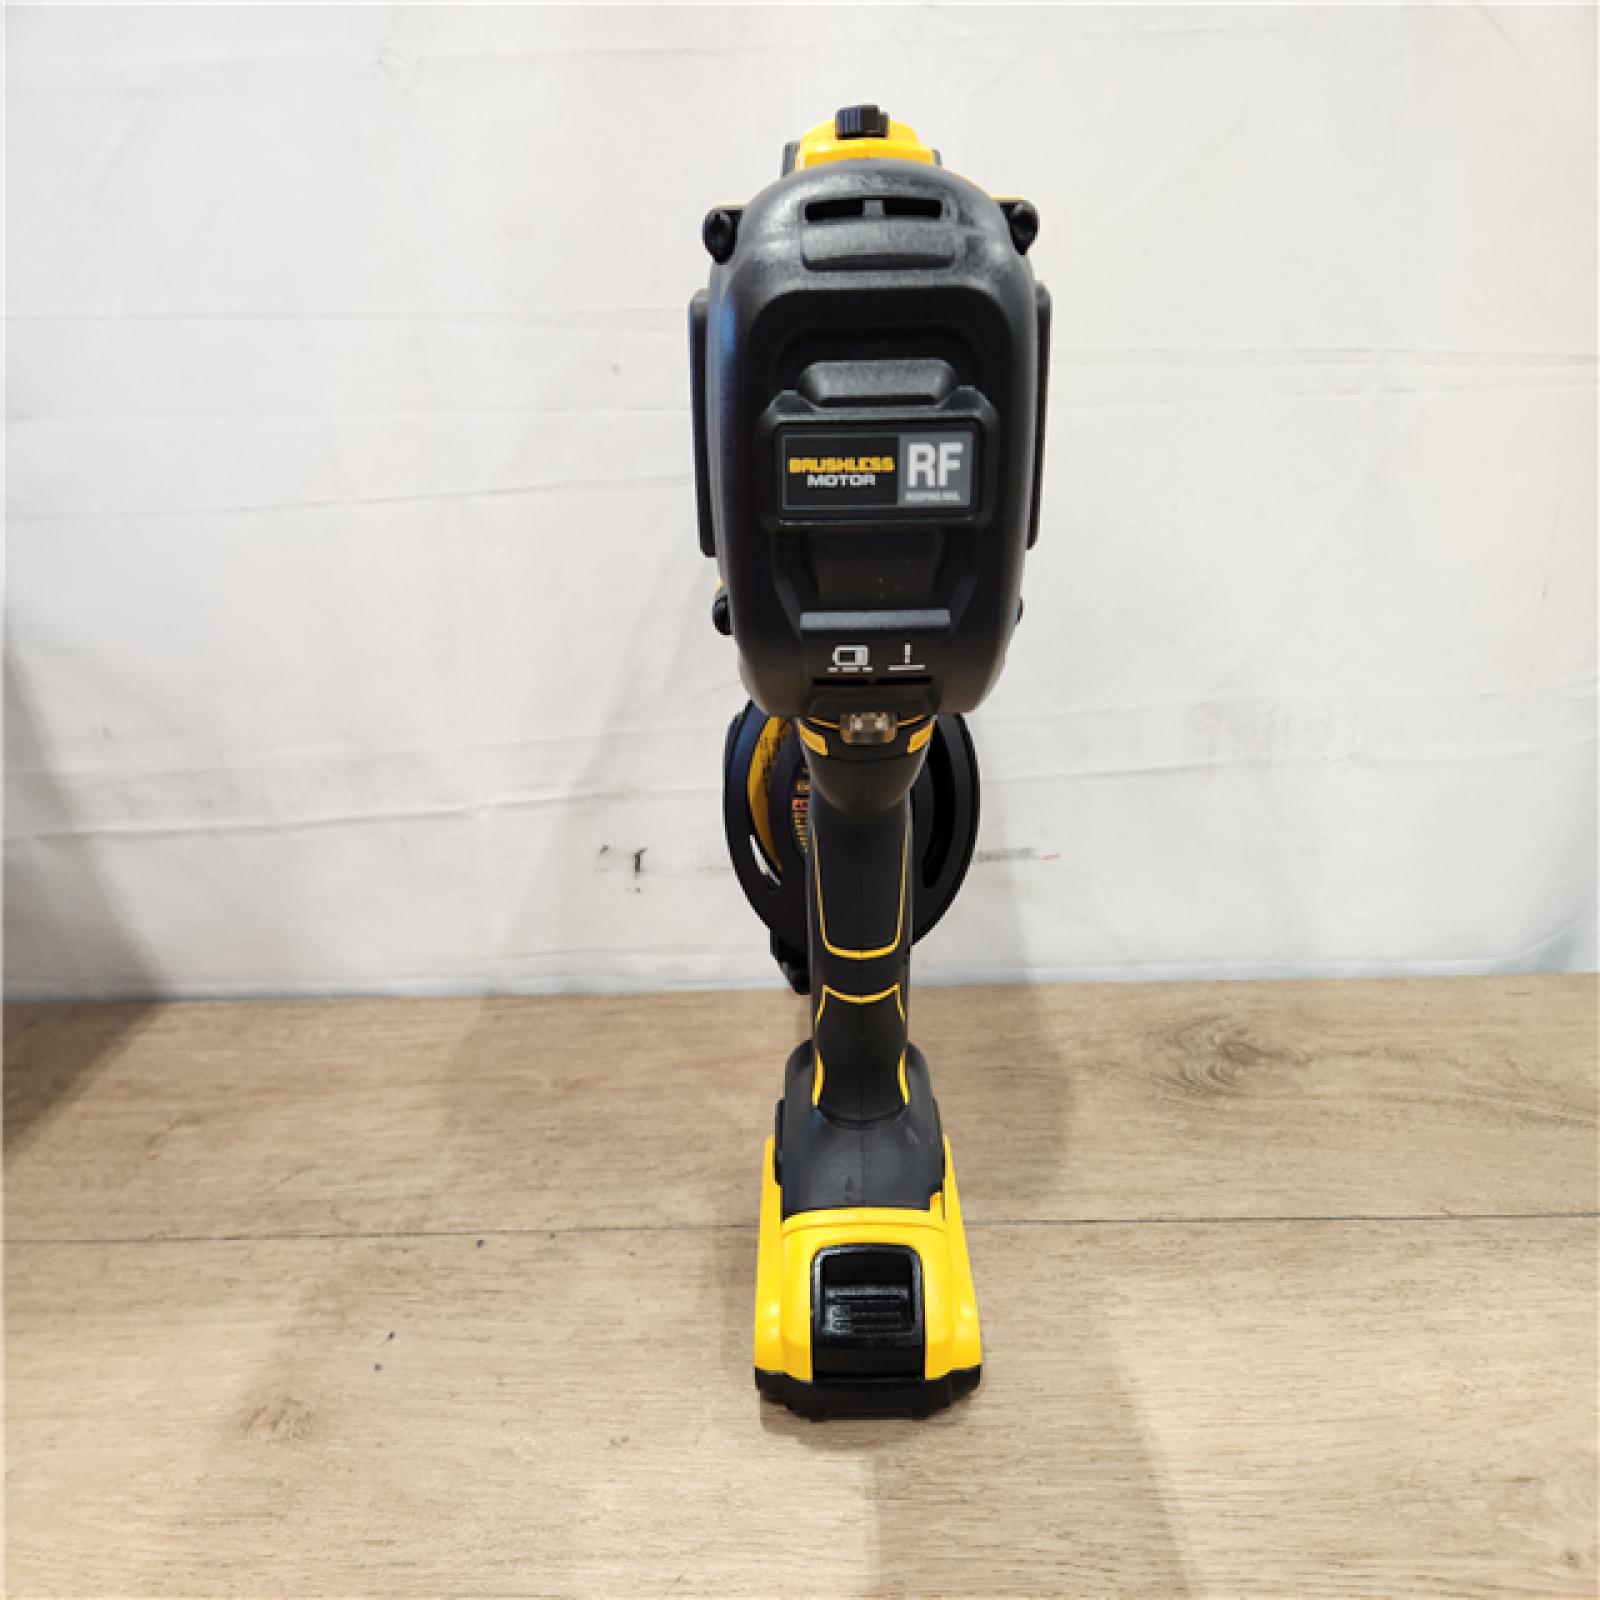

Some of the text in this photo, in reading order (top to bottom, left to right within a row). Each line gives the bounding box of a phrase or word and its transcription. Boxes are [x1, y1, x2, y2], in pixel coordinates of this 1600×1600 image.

[788, 457, 895, 474] BRUSHLESS
[907, 442, 963, 487] RF
[807, 474, 876, 487] MOTOR
